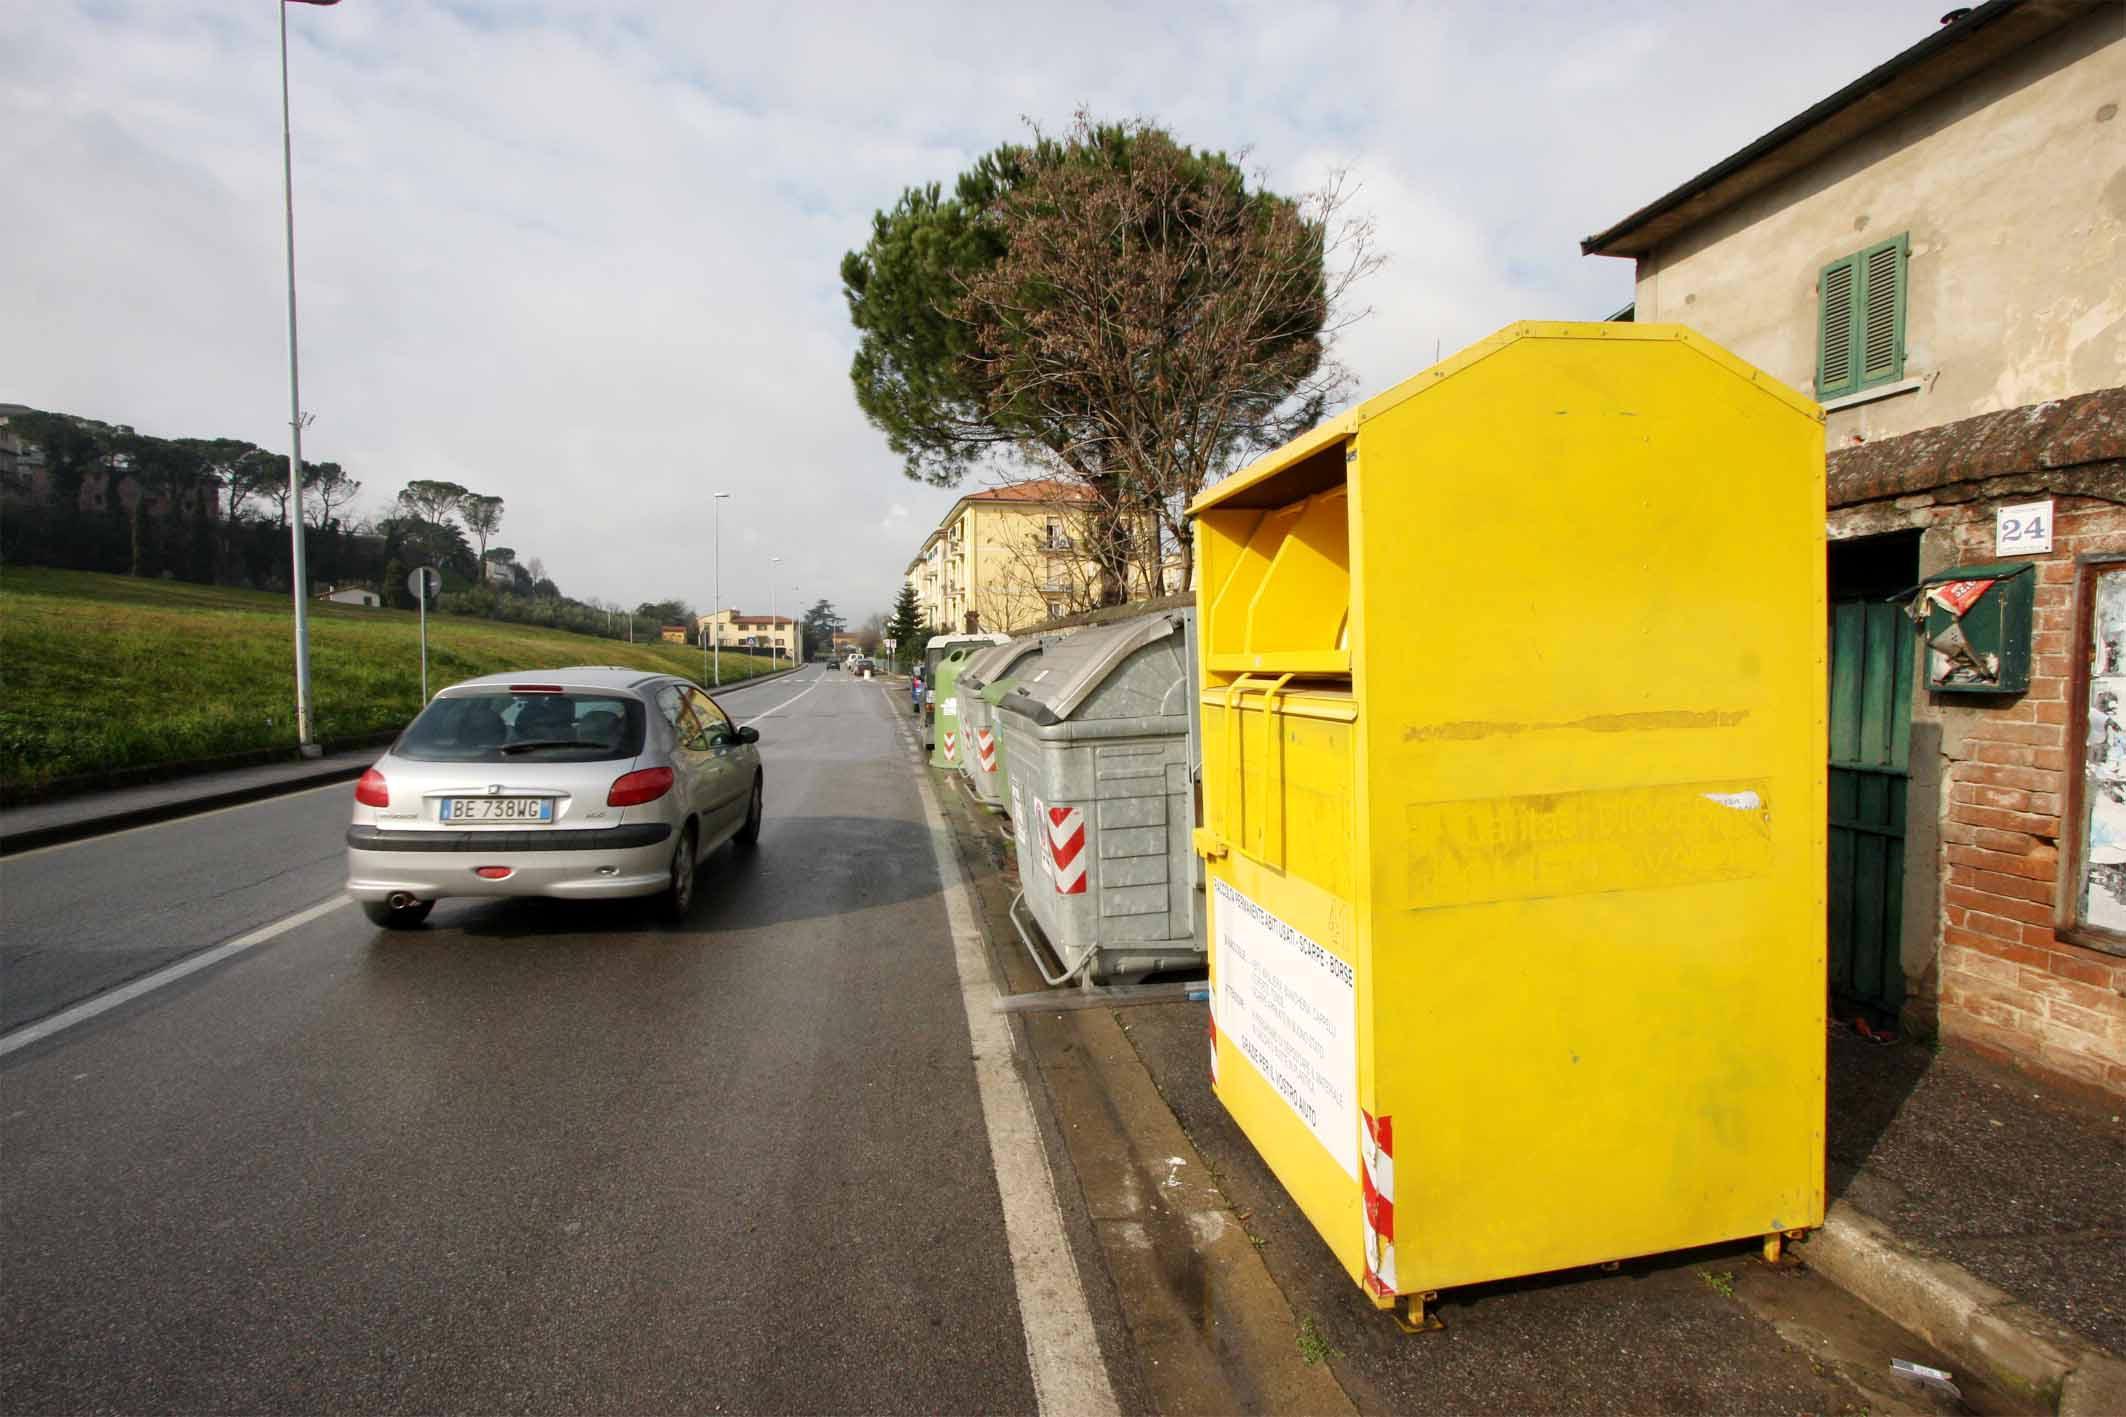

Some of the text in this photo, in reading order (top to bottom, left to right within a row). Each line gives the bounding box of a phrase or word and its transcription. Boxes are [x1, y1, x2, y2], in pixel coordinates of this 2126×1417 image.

[2001, 516, 2046, 542] 24
[454, 800, 539, 818] BE 738WG
[1299, 935, 1325, 968] SCARPE
[1330, 955, 1352, 988] BORSE
